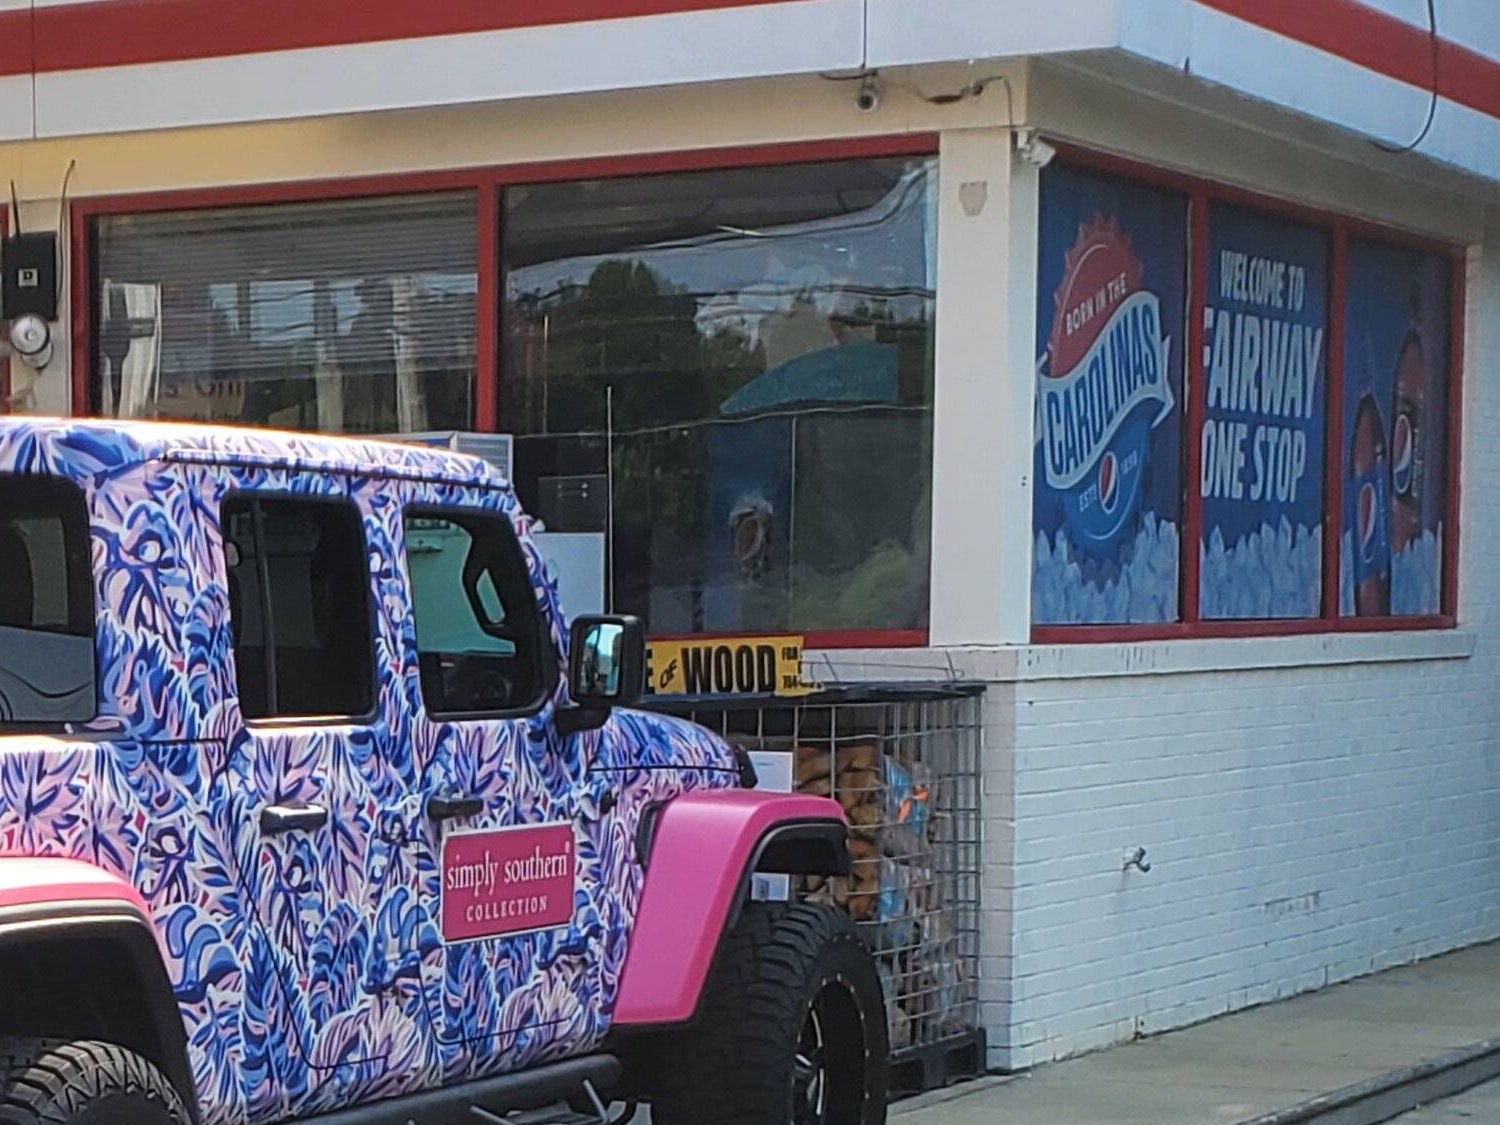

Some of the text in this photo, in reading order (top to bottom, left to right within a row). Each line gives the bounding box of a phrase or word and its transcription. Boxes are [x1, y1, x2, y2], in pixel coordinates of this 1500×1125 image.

[1066, 272, 1127, 336] BORN IN THE
[1221, 250, 1304, 312] WELCOME TO
[1046, 304, 1158, 476] CAROLINAS
[1200, 419, 1307, 504] ONE STOP
[680, 644, 777, 694] WOOD
[446, 844, 568, 897] simply southern
[466, 895, 548, 922] COLLECTION
